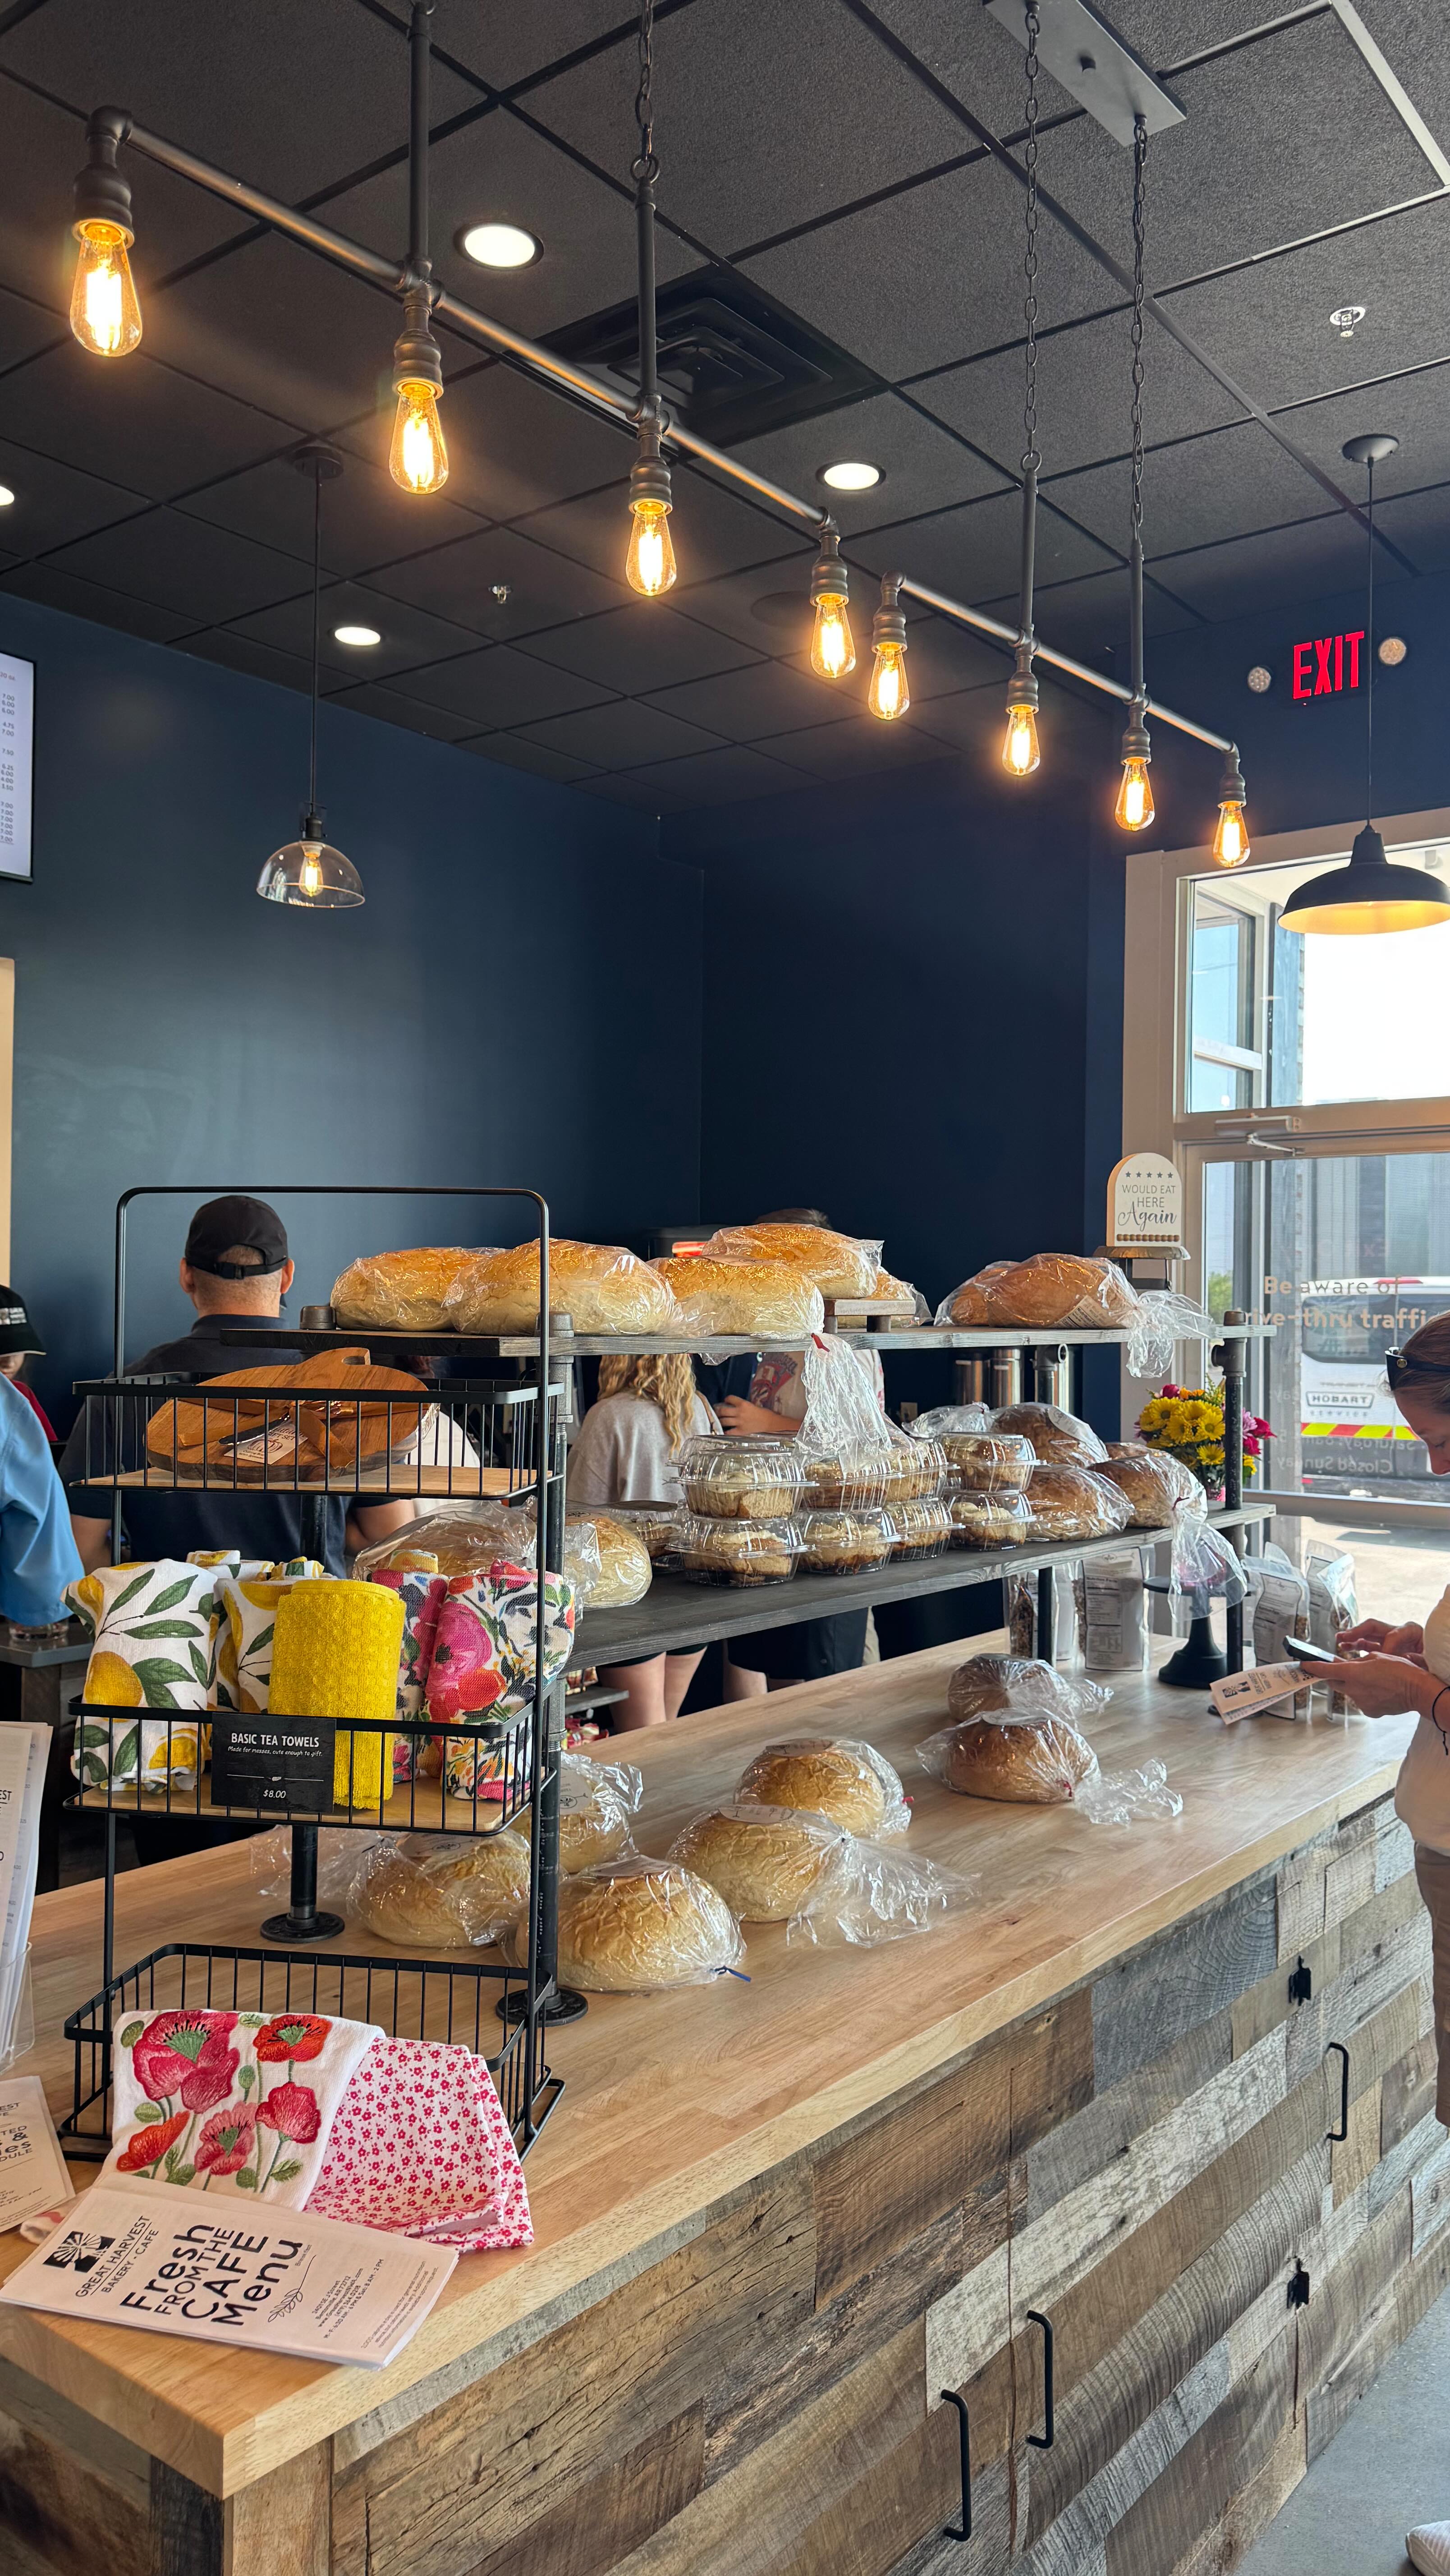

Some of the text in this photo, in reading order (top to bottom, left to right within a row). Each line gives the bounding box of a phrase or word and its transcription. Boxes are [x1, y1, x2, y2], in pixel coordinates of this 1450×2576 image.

[1293, 630, 1364, 699] EXIT
[1122, 1185, 1176, 1194] WOULD EAT
[1137, 1197, 1165, 1208] HERE
[1118, 1201, 1177, 1232] Again
[1264, 1276, 1292, 1295] Be
[1300, 1281, 1368, 1295] aware
[1237, 1308, 1352, 1328] rive-thru
[1312, 1395, 1367, 1404] HOBART
[231, 1733, 319, 1748] BASIC TEA TOWELS
[263, 1789, 286, 1799] $8.00
[75, 2215, 150, 2297] GREAT HARVEST
[101, 2261, 134, 2293] BAKERY
[135, 2229, 159, 2255] CAFE
[119, 2224, 215, 2311] Fresh
[154, 2228, 235, 2315] FROM THE
[181, 2231, 269, 2319] CAFE
[211, 2240, 303, 2326] Menu
